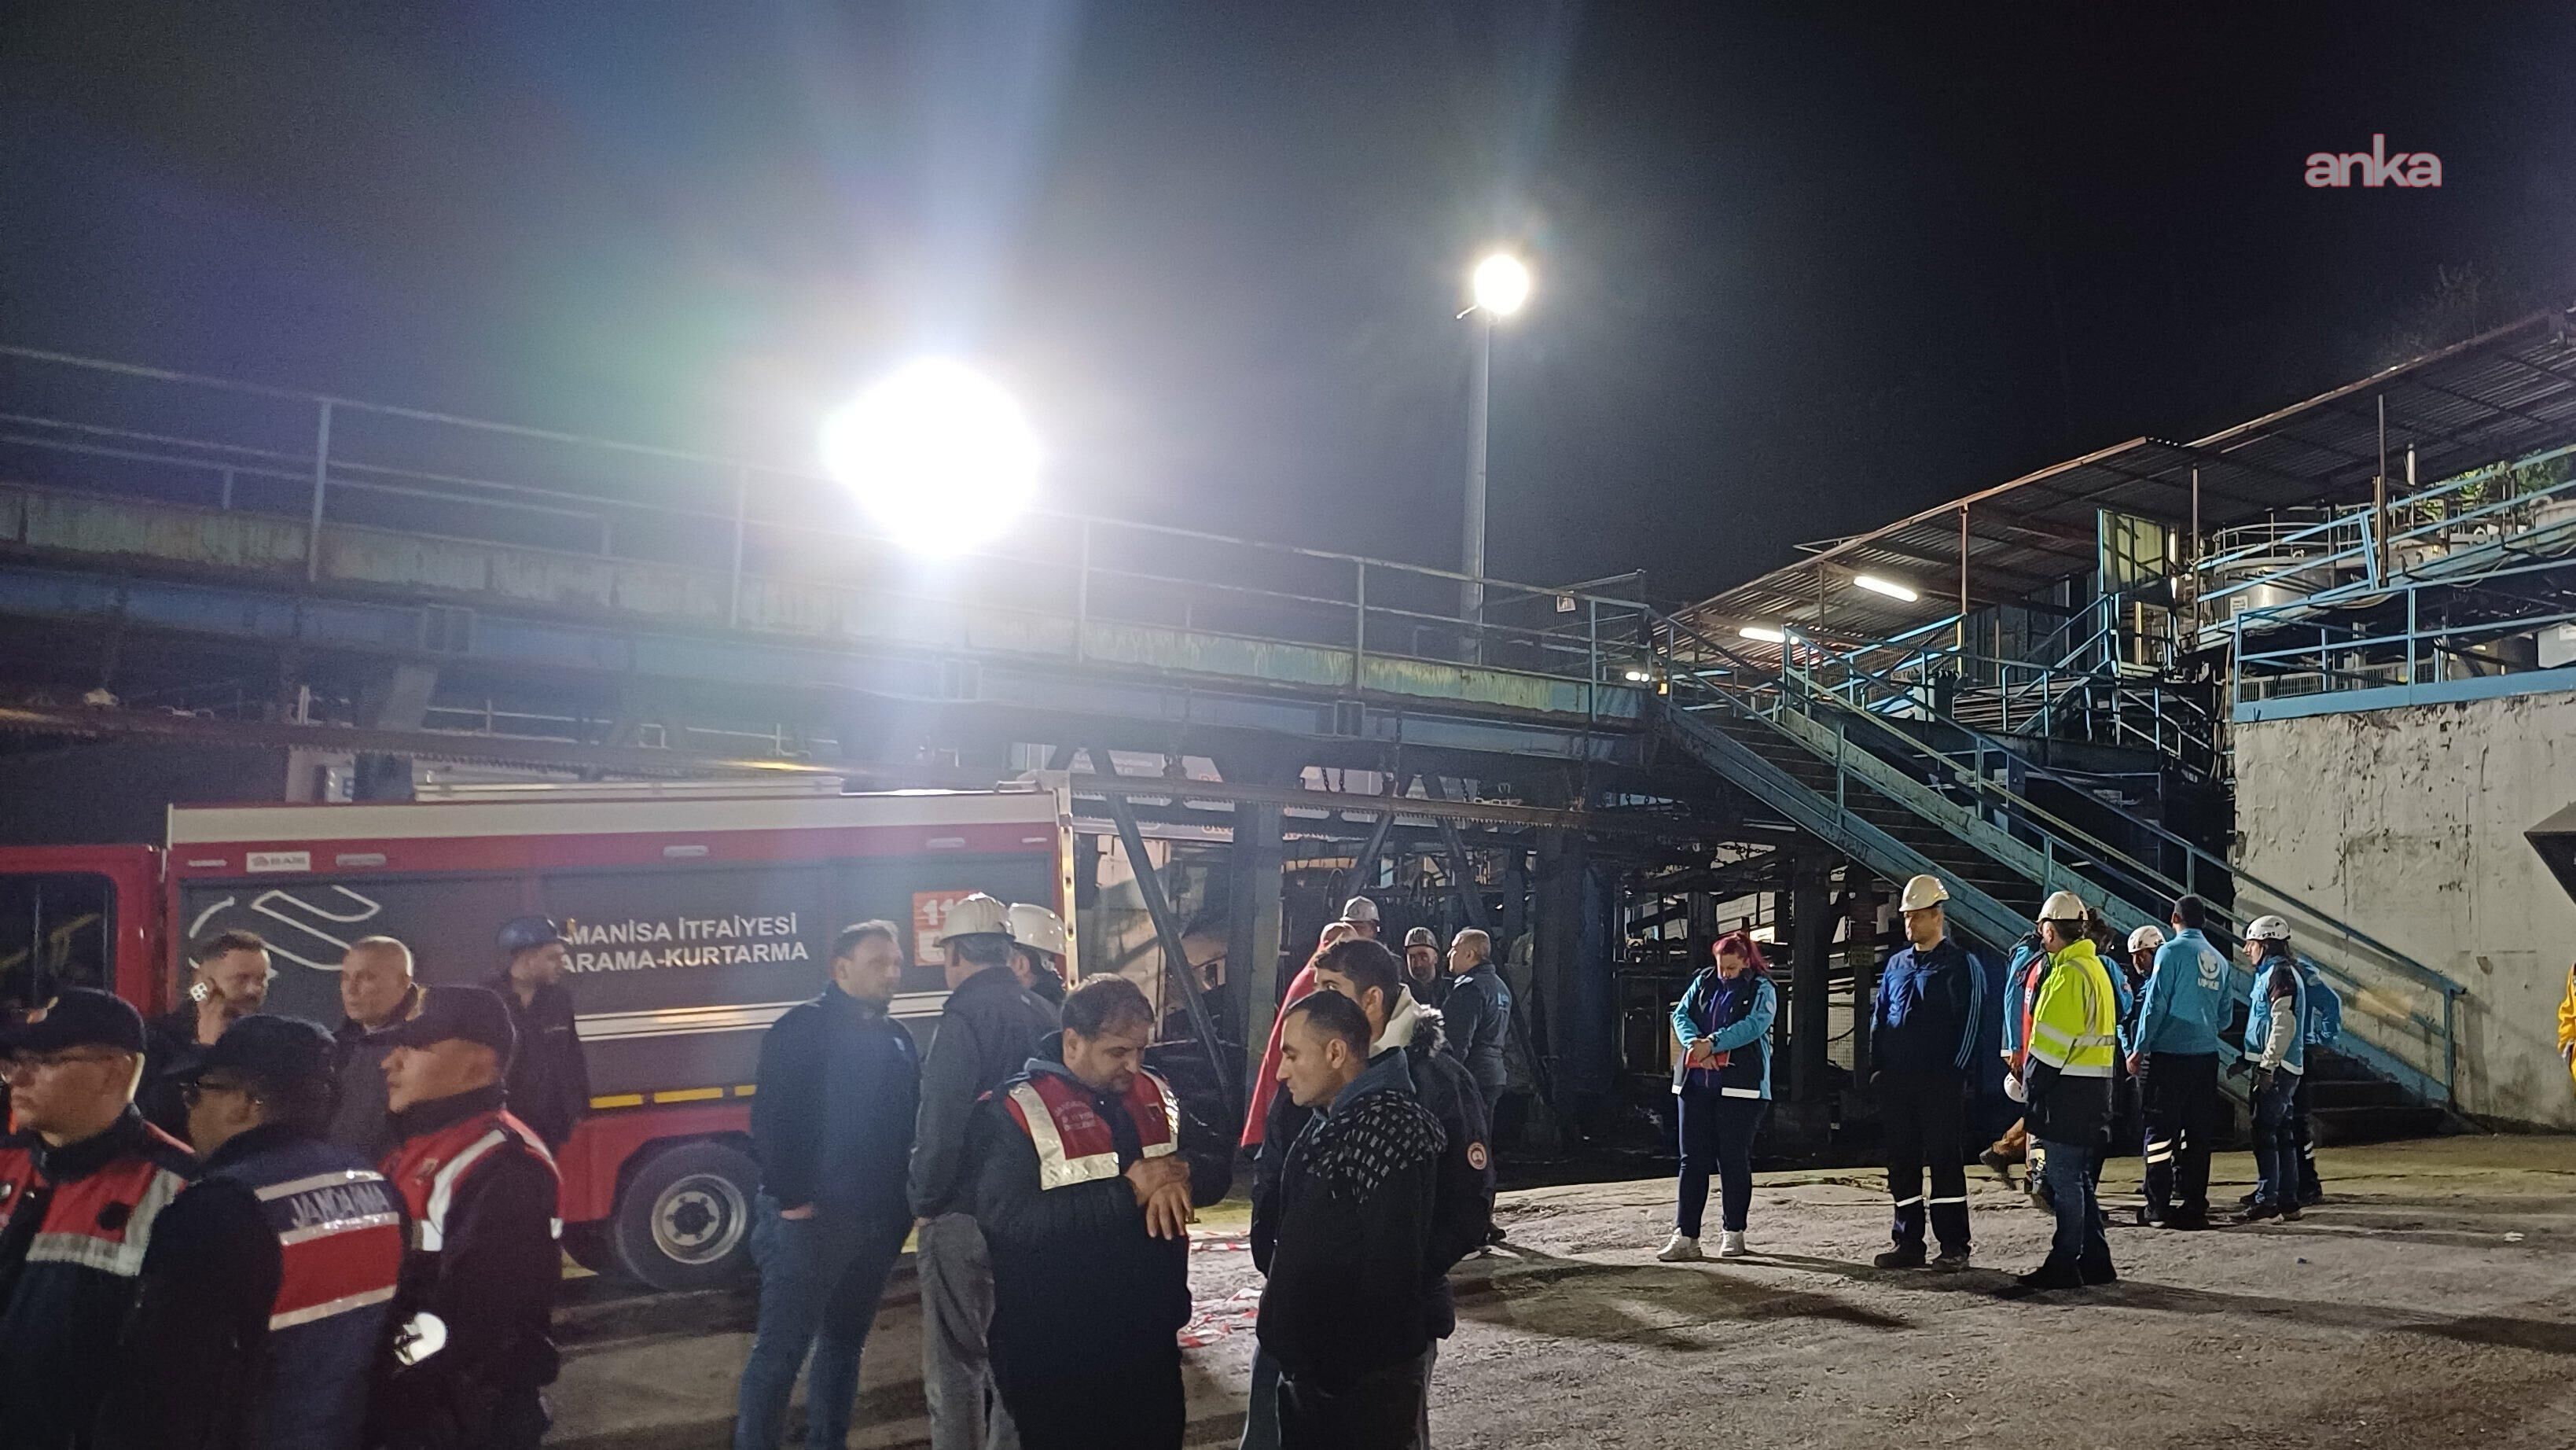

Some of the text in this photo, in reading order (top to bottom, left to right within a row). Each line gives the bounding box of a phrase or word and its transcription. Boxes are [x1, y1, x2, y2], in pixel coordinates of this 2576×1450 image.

[568, 911, 797, 944] MANİSA İTFAİYESİ
[560, 941, 809, 973] ARAMA-KURTARMA
